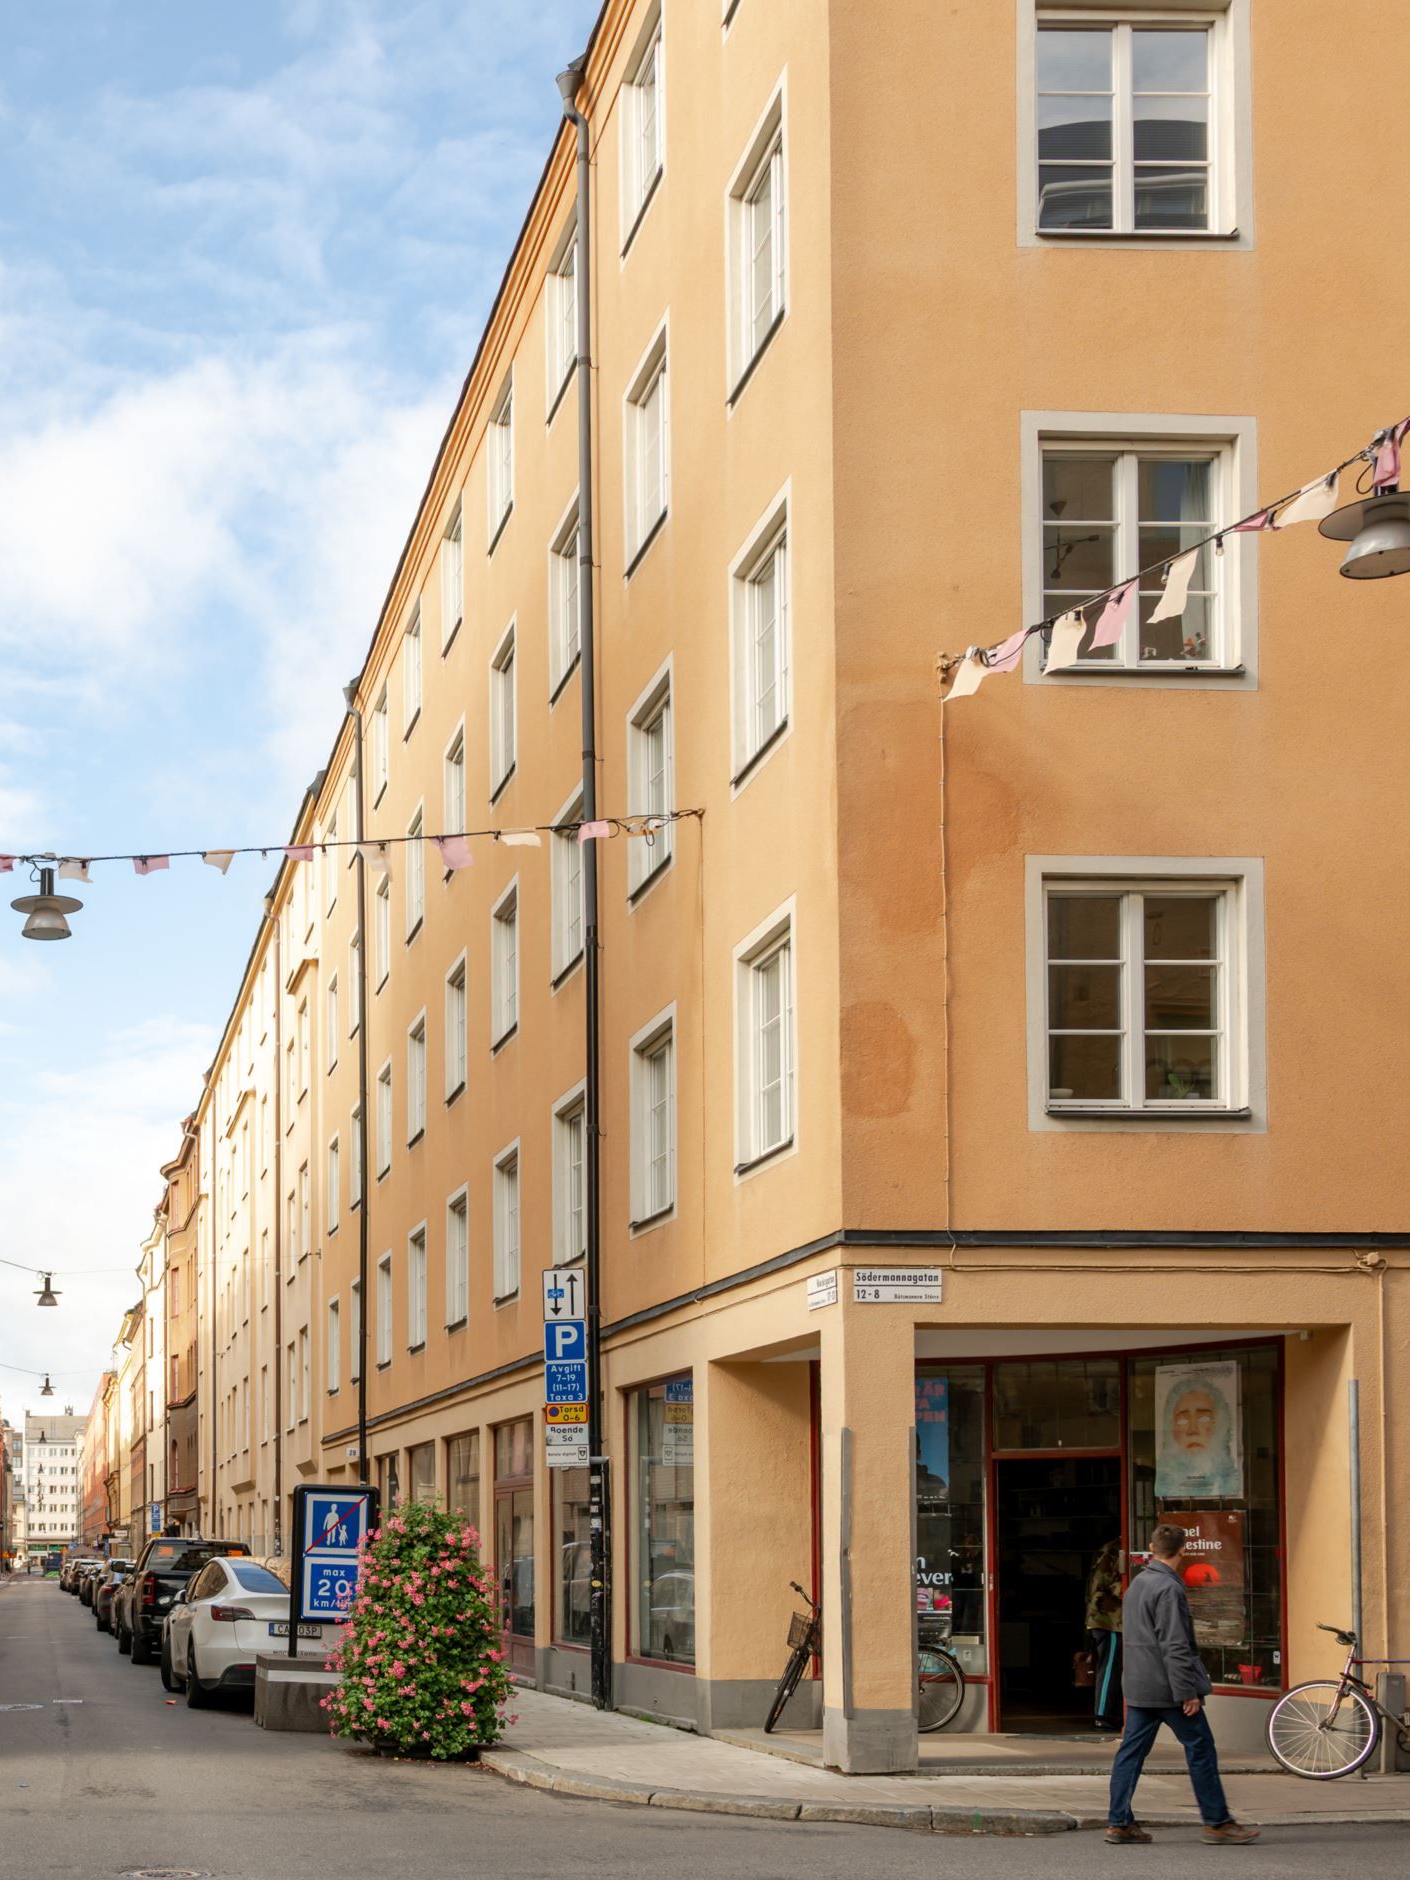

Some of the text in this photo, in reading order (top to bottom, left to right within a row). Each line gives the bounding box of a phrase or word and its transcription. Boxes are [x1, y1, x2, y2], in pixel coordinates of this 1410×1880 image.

[855, 1271, 939, 1284] Södermannagatan
[554, 1325, 579, 1358] P
[550, 1364, 581, 1374] Avgift
[556, 1374, 576, 1382] 7-19
[552, 1383, 580, 1392] (11-17)
[550, 1392, 583, 1401] Taxa 3
[559, 1405, 584, 1414] Torsd
[153, 1505, 159, 1513] P
[1183, 1526, 1200, 1537] nel
[1184, 1539, 1222, 1550] estine
[323, 1568, 346, 1576] max
[317, 1579, 352, 1596] 20
